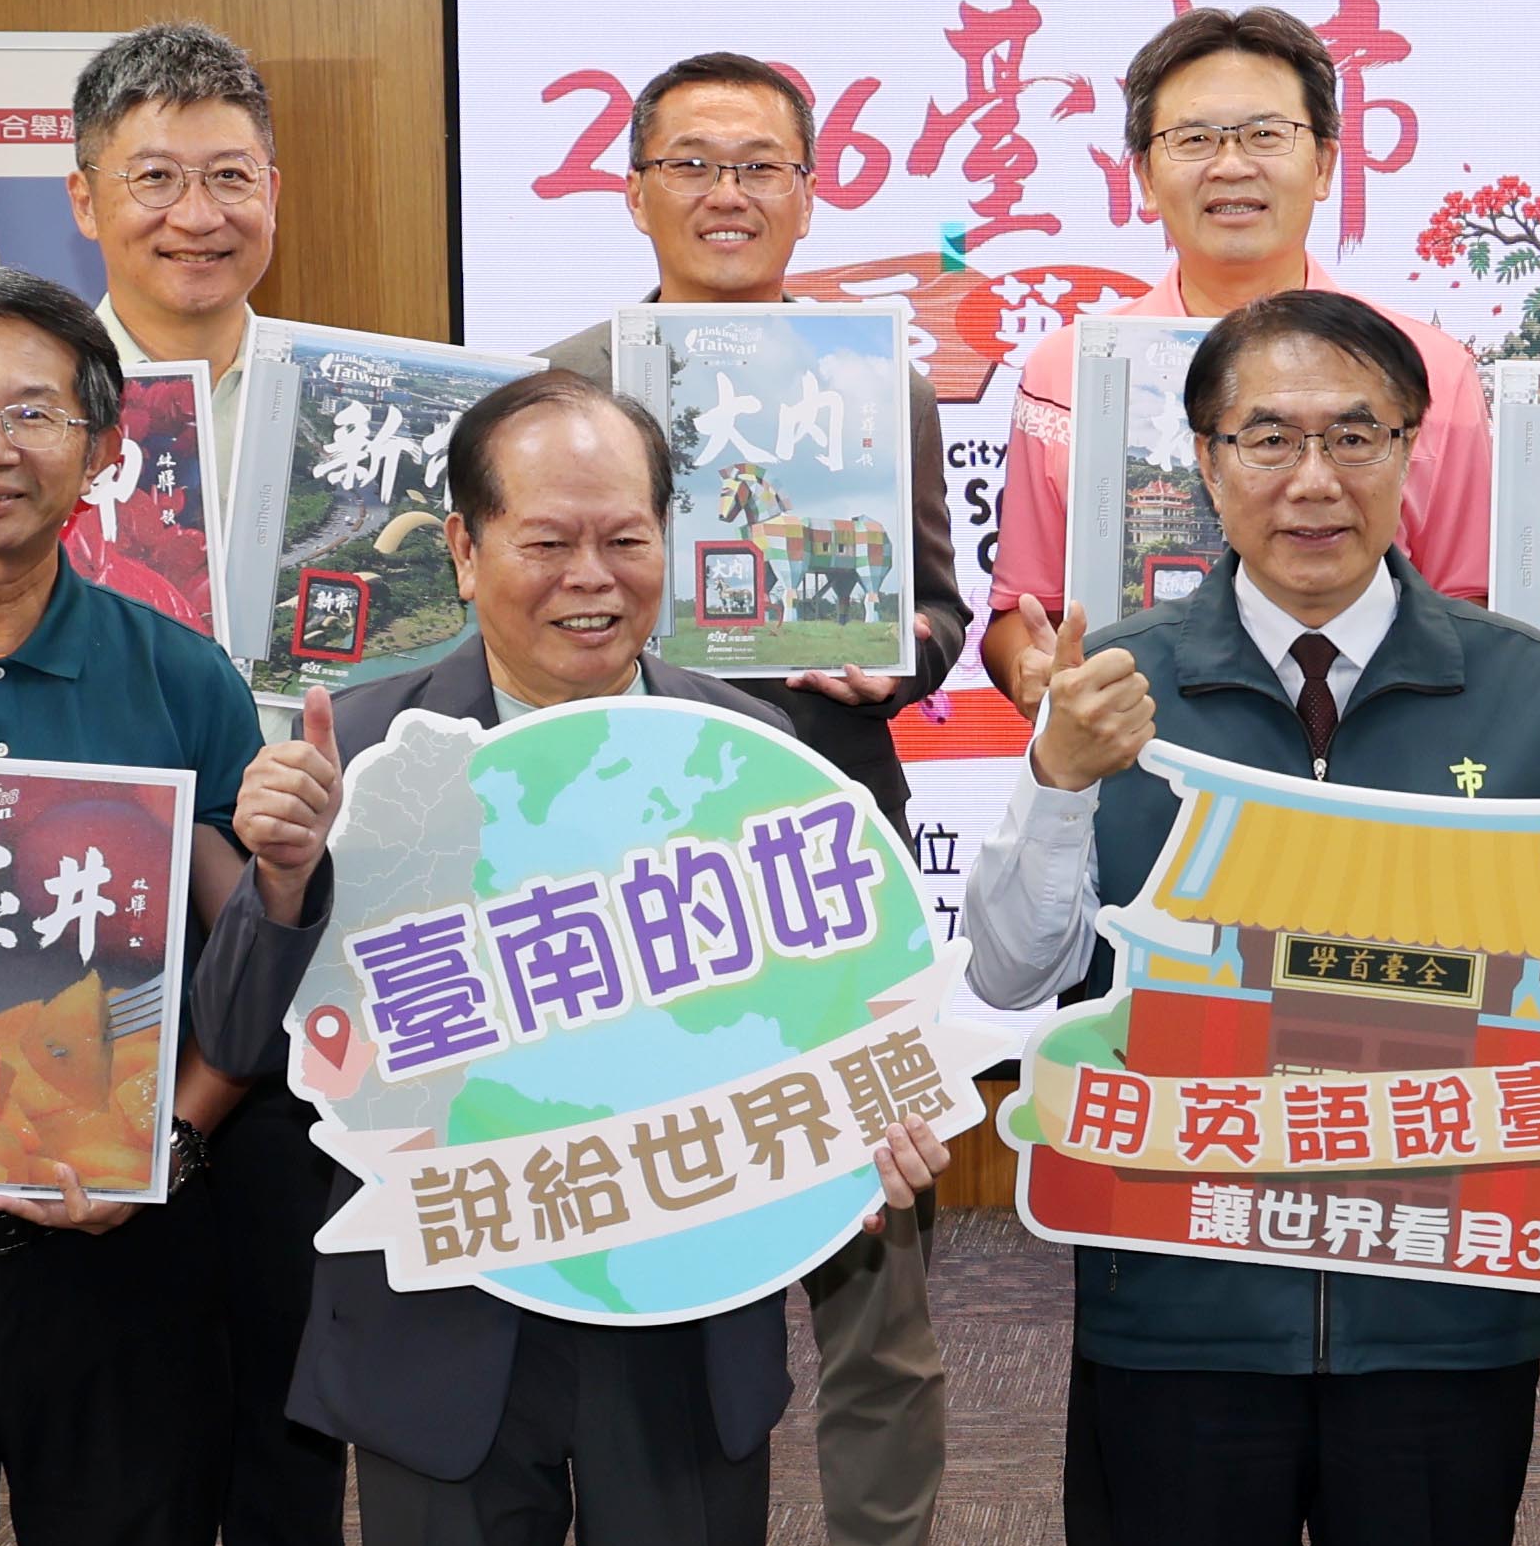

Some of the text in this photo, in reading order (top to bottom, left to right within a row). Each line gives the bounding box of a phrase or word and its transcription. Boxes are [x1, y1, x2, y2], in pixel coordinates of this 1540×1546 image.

[692, 370, 845, 473] 大內
[353, 800, 876, 1073] 臺南的好
[409, 1026, 956, 1267] 說給世界聽
